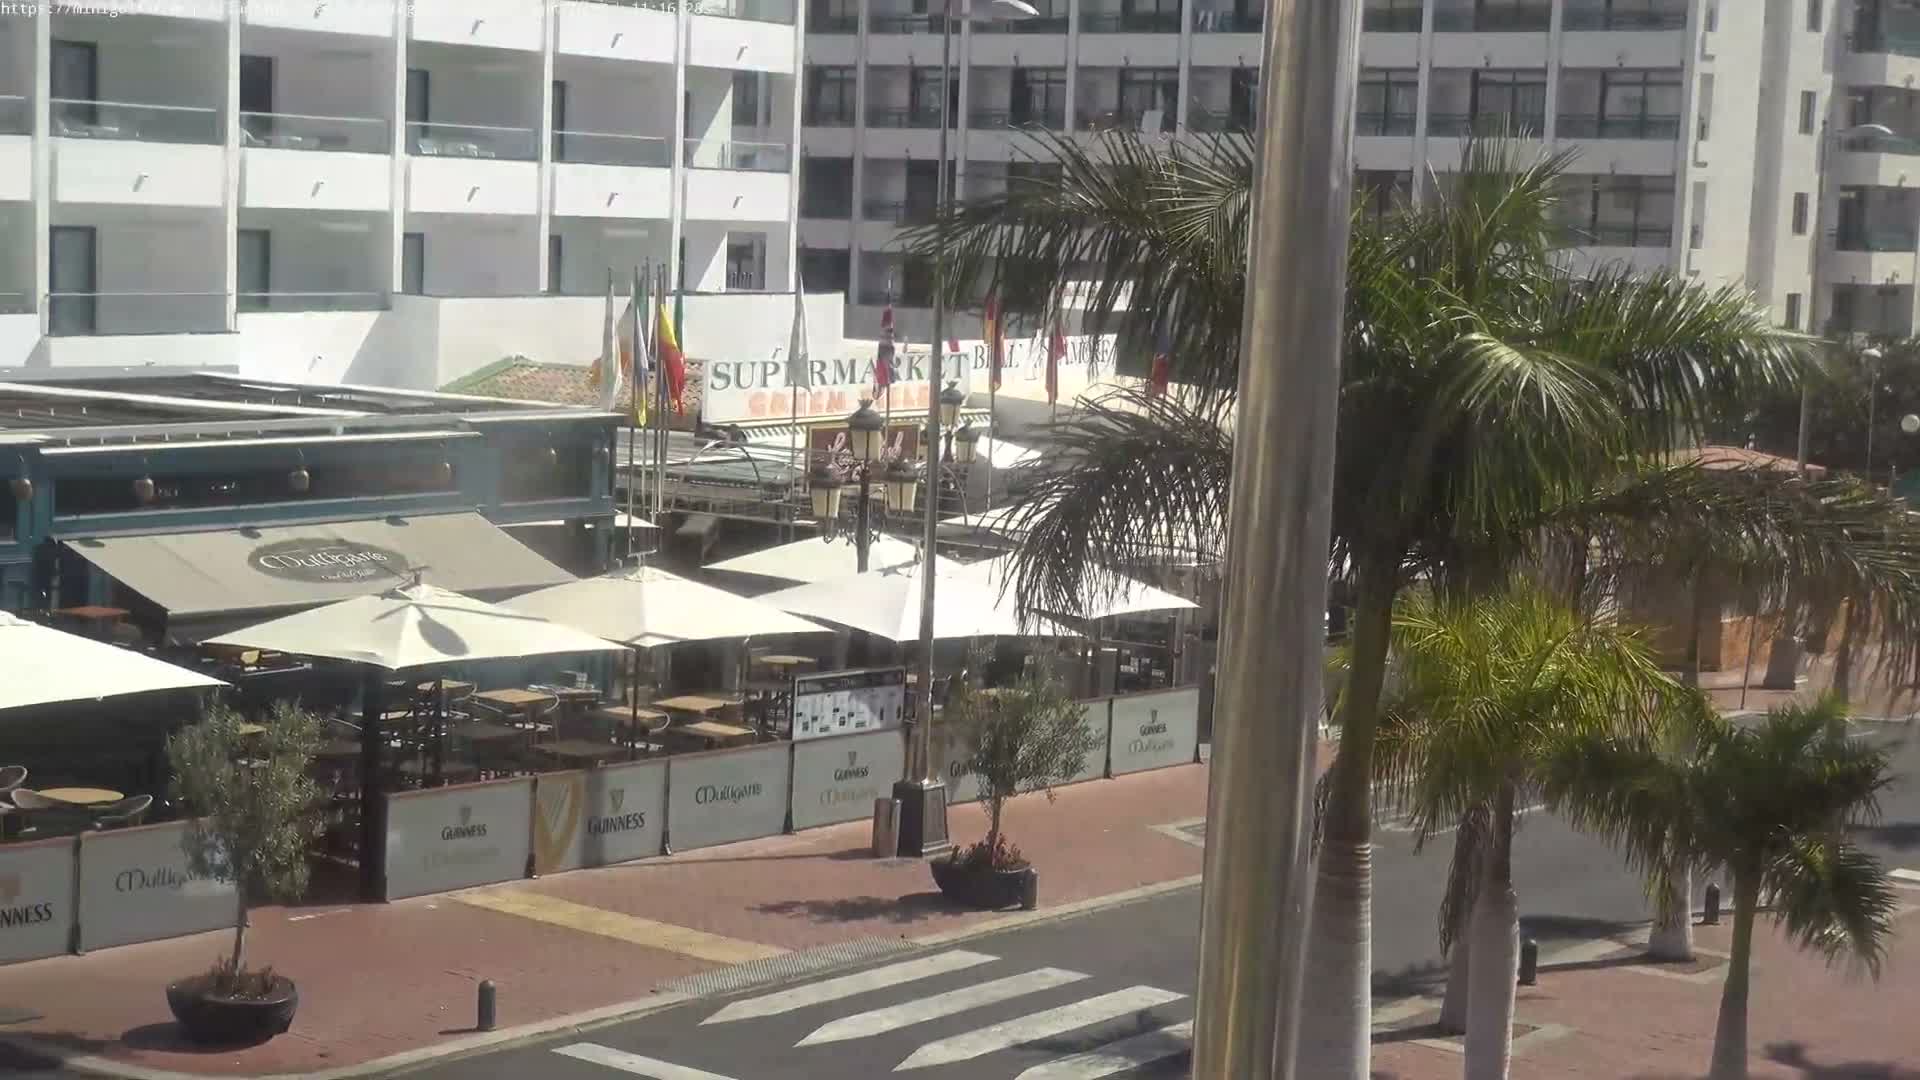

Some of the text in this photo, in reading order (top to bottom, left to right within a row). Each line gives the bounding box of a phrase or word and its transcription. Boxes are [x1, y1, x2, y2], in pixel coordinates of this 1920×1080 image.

[710, 352, 970, 391] SUPRMARKT
[834, 767, 869, 781] GUINNESS
[695, 783, 763, 806] Mulligans
[441, 824, 488, 841] GUINNESS
[588, 811, 647, 834] GUINNESS
